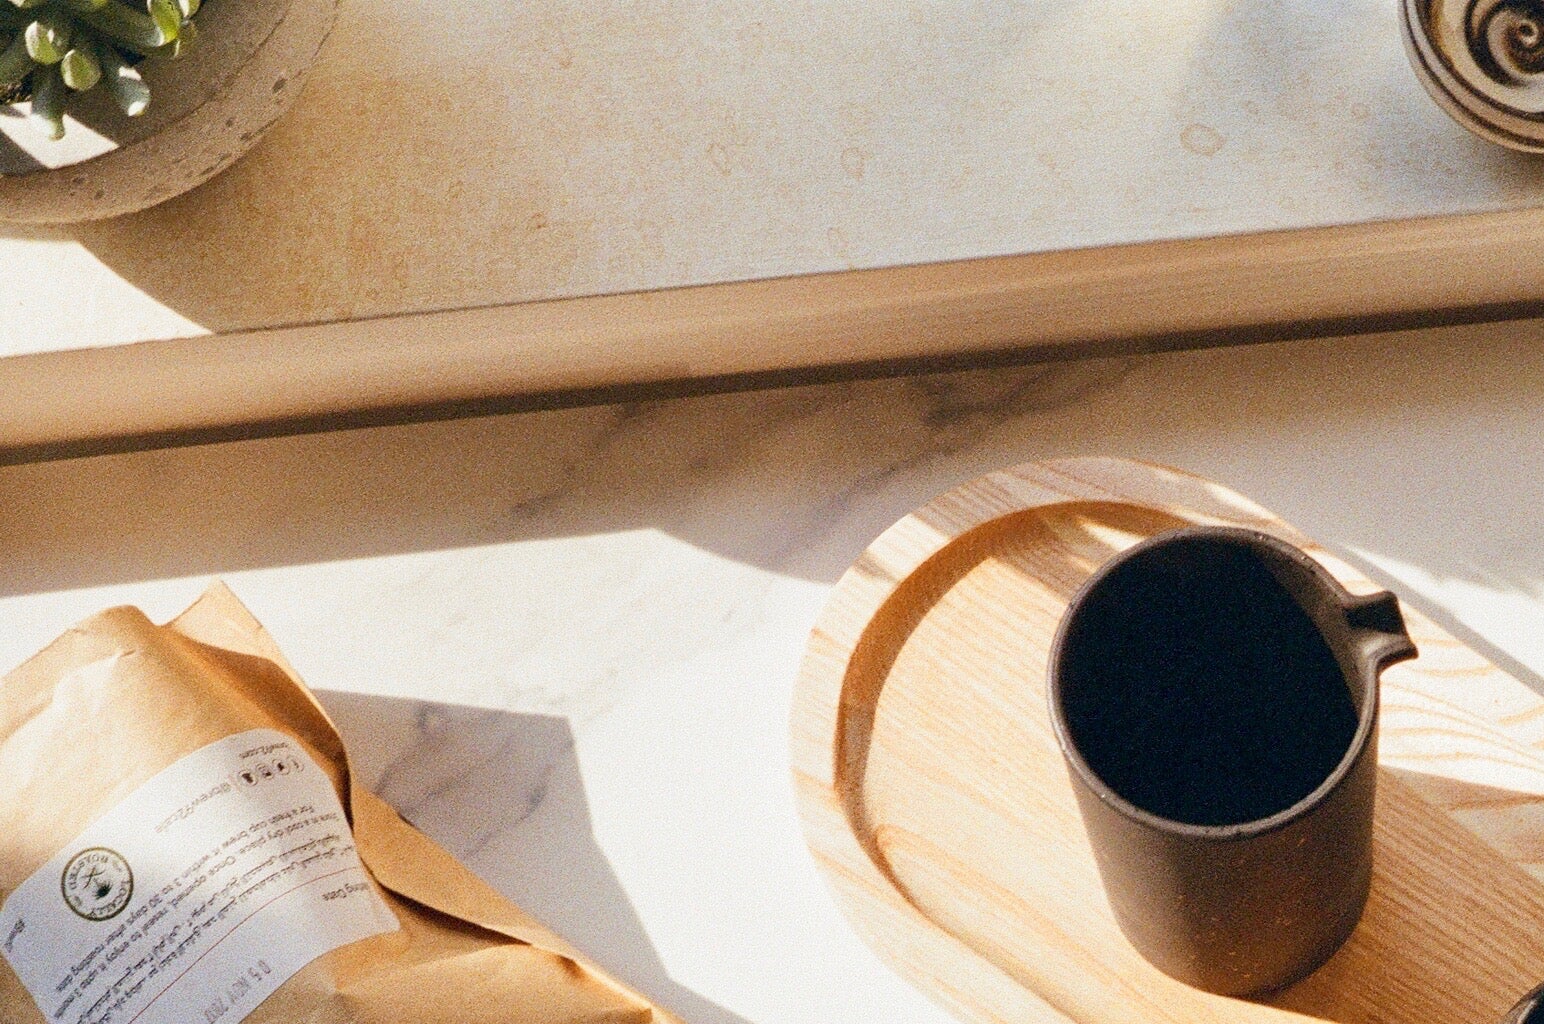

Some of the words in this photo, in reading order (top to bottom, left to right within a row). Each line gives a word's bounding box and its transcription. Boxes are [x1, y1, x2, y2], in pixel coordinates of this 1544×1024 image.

[249, 820, 268, 833] cup
[222, 830, 248, 848] brew
[208, 855, 237, 876] Once
[88, 880, 130, 919] LOCALLY
[148, 894, 163, 909] 30
[126, 904, 148, 926] days
[105, 941, 131, 963] enjoy
